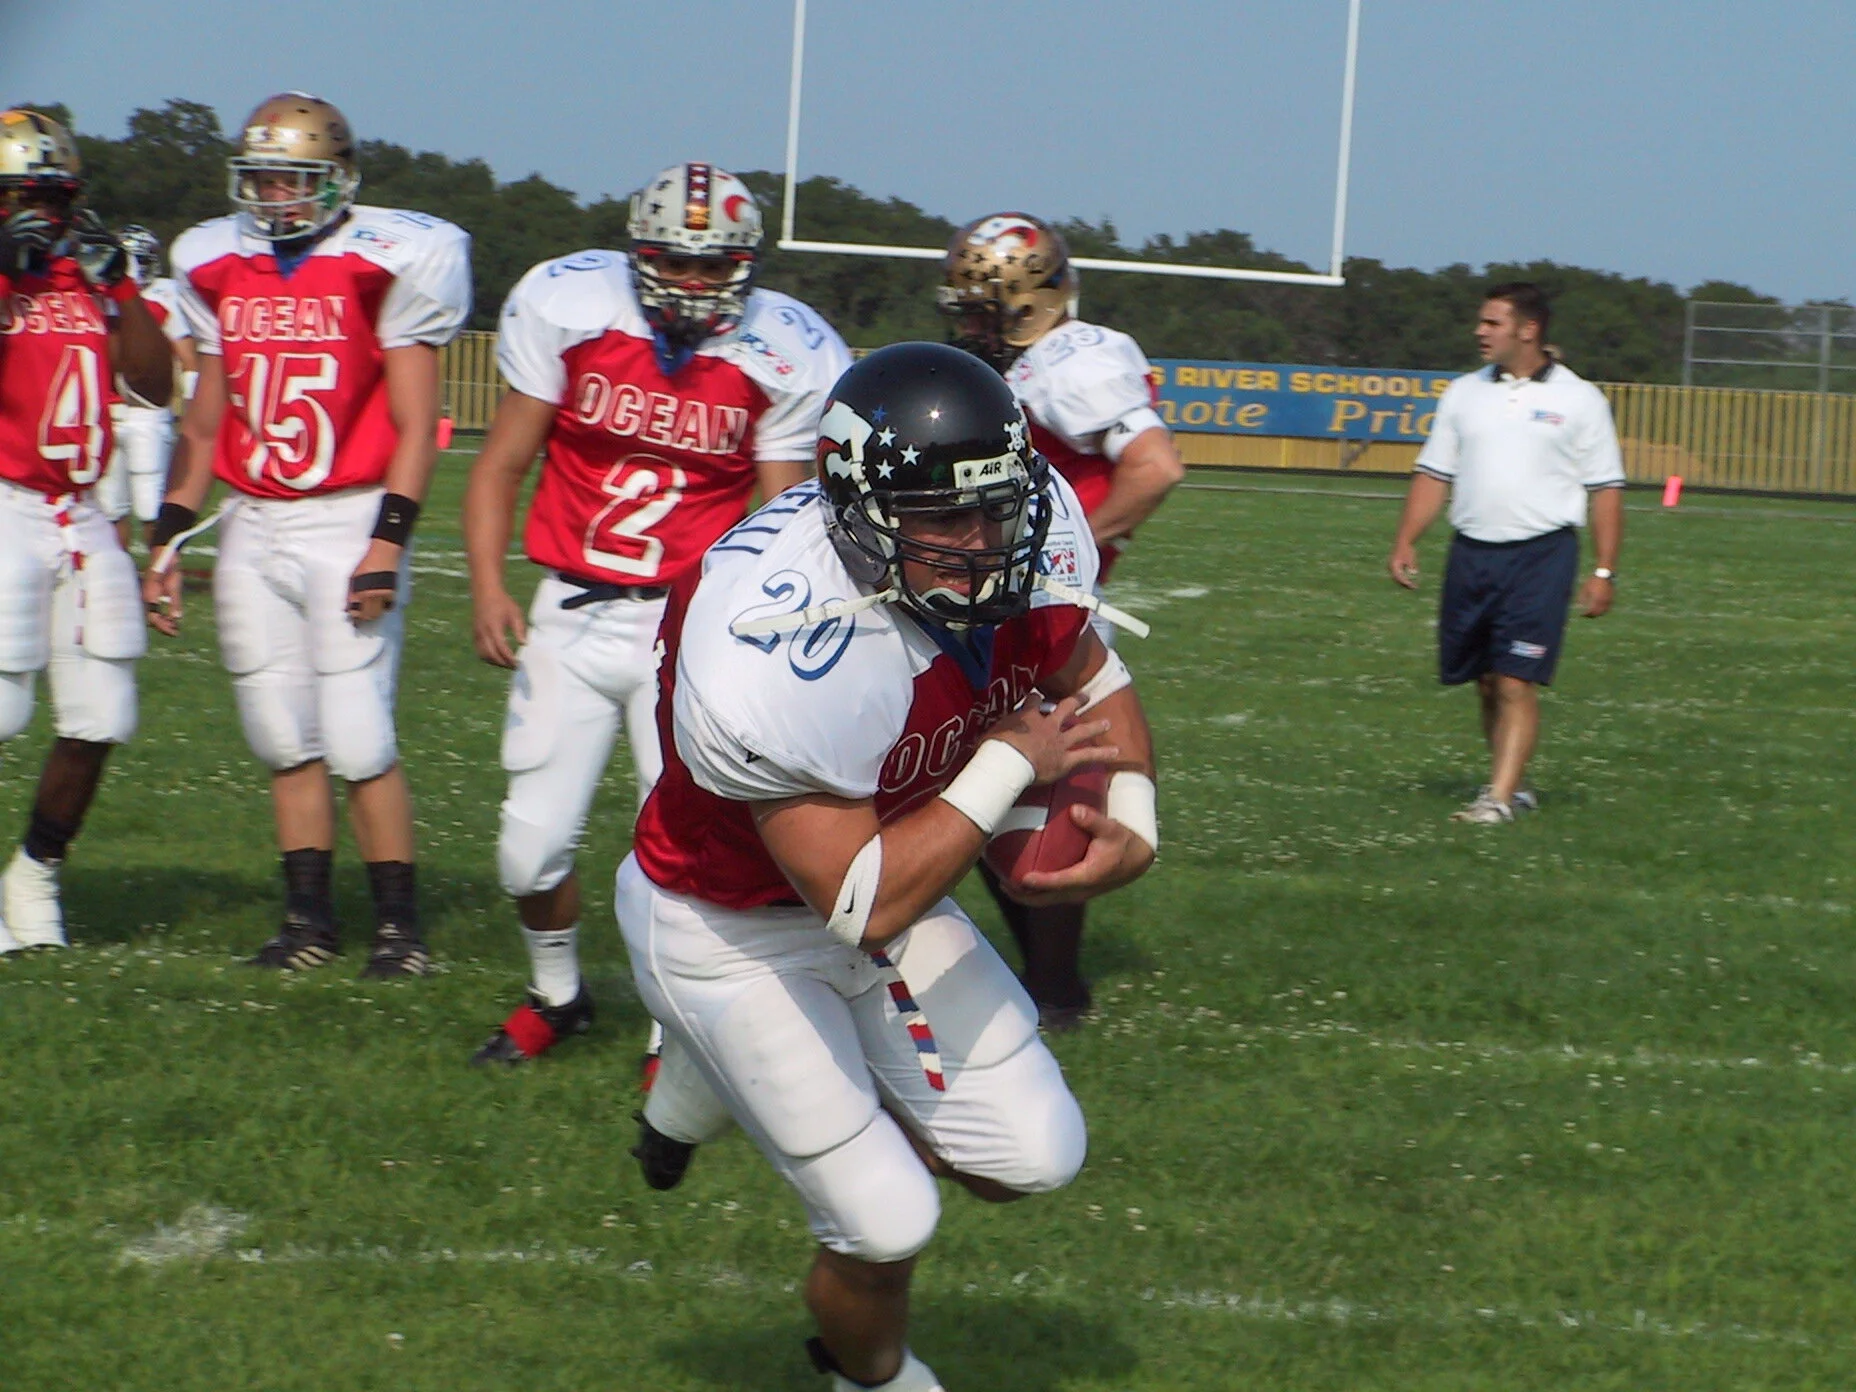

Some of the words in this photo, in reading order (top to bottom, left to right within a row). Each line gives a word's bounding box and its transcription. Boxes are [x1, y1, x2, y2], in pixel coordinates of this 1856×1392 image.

[37, 344, 105, 485] 4
[228, 352, 340, 491] 15
[577, 372, 749, 455] OCEAN
[1175, 366, 1280, 392] RIVER
[1288, 371, 1451, 399] SCHOOLS
[583, 452, 689, 578] 2
